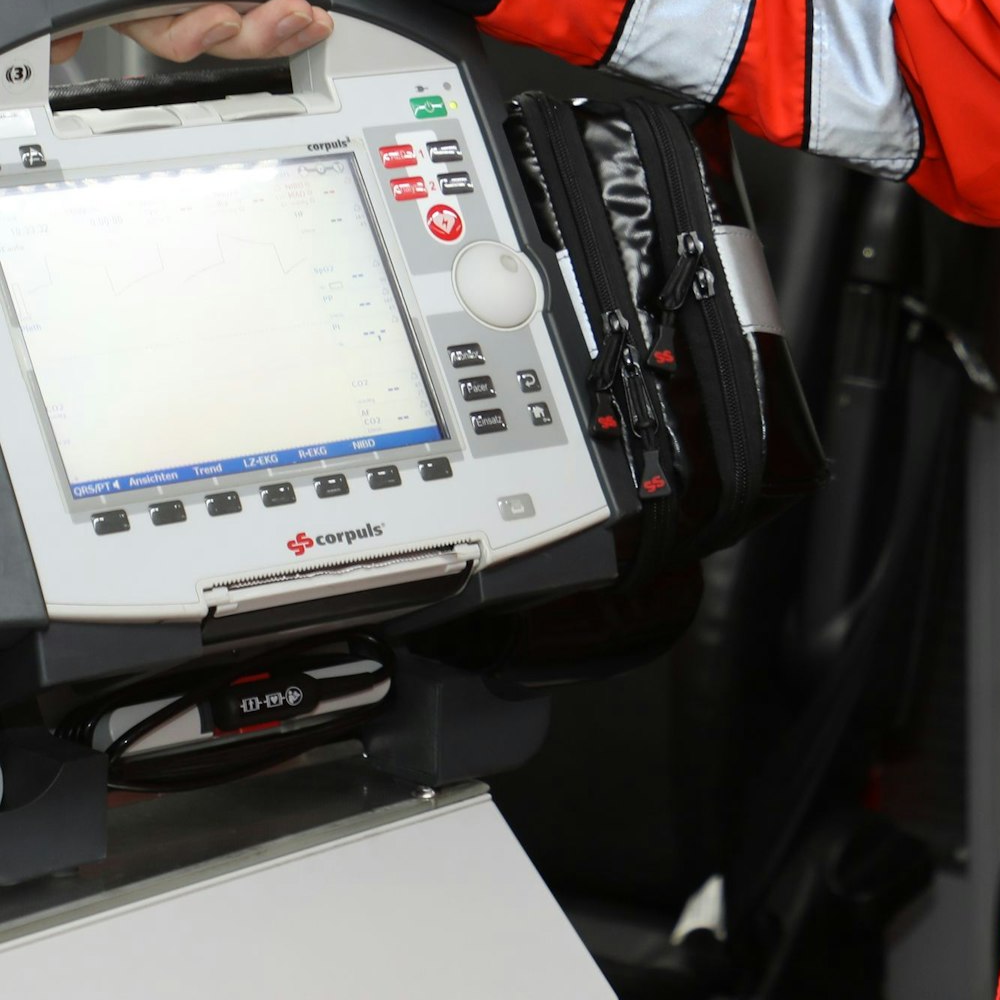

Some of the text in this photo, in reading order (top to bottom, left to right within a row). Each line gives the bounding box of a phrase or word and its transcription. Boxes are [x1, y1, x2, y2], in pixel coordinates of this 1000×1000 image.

[466, 383, 488, 394] Pacer
[475, 415, 502, 427] Einsatz
[74, 438, 376, 497] QRS/PT Ansichten Trend LZ-EKG R-EKG NIBD
